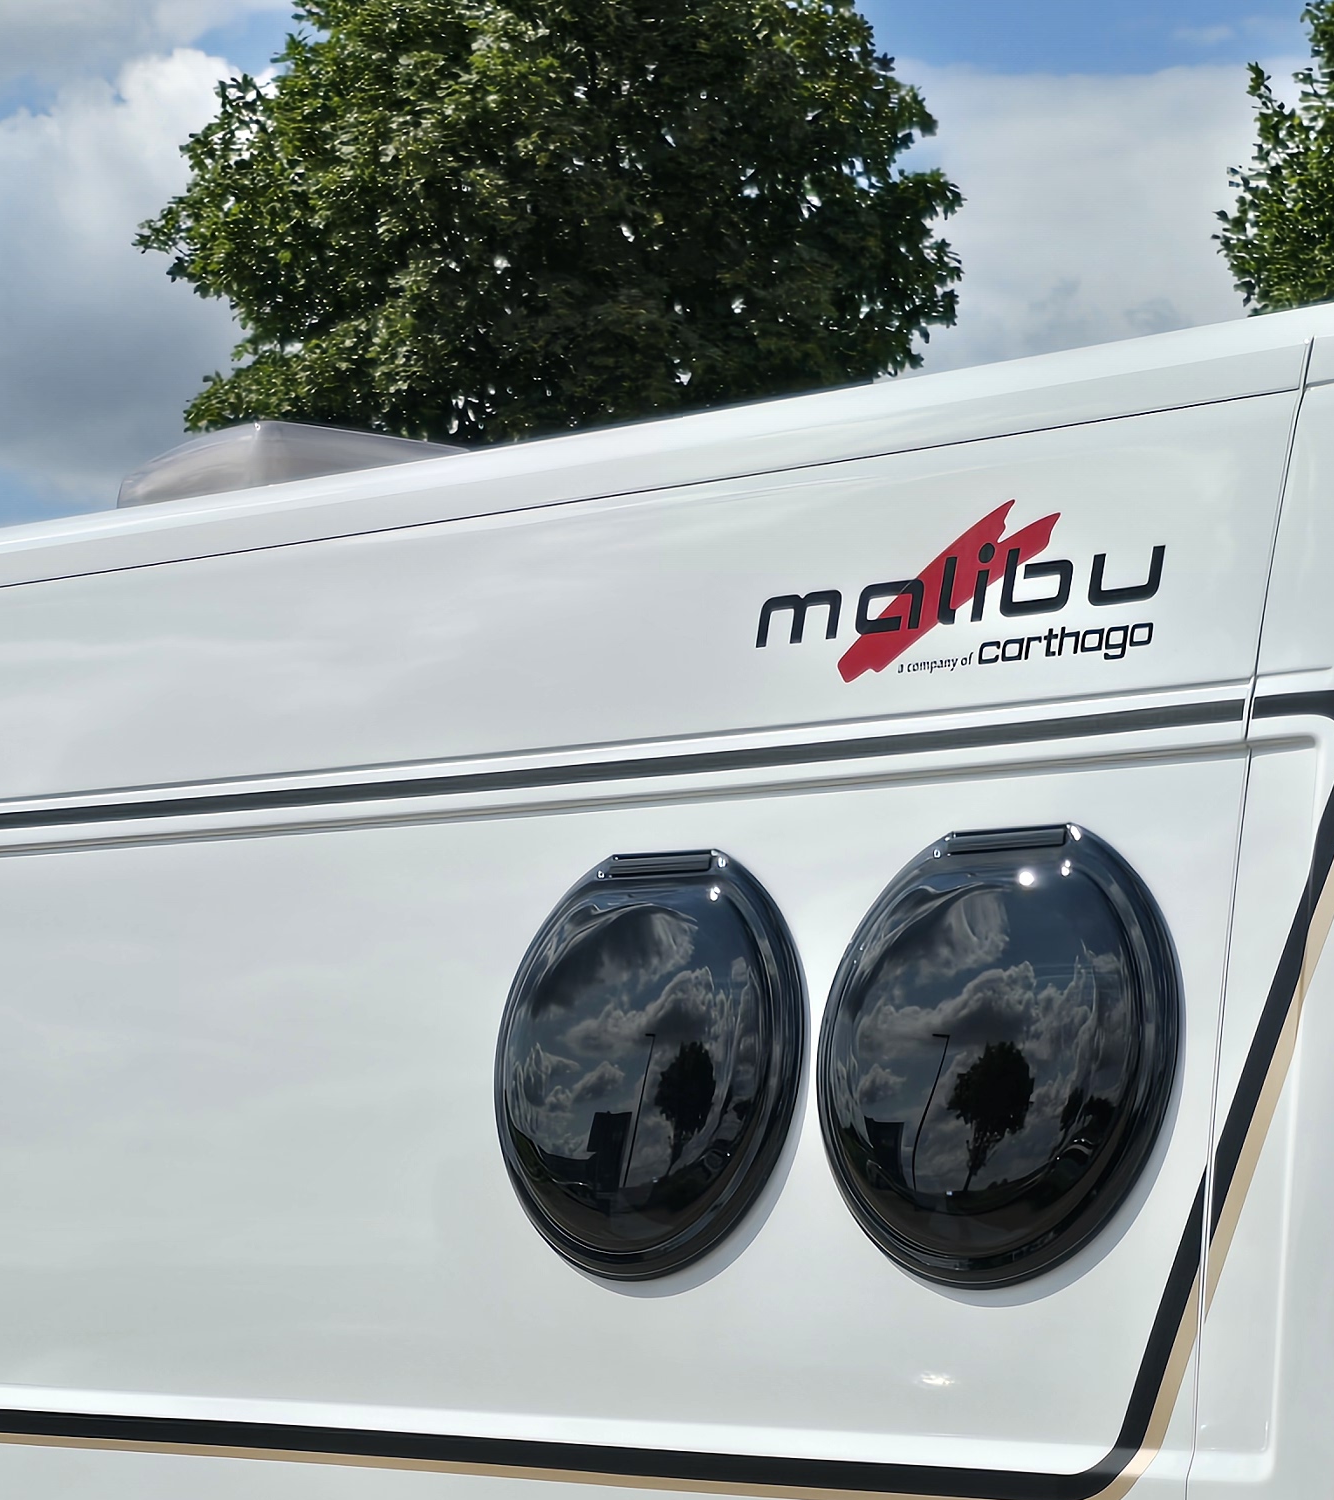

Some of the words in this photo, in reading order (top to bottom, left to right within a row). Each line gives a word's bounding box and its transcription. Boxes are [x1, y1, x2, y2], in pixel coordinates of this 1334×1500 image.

[755, 542, 1166, 648] malibu
[907, 658, 958, 674] company
[960, 651, 974, 666] of
[977, 621, 1155, 665] carthago
